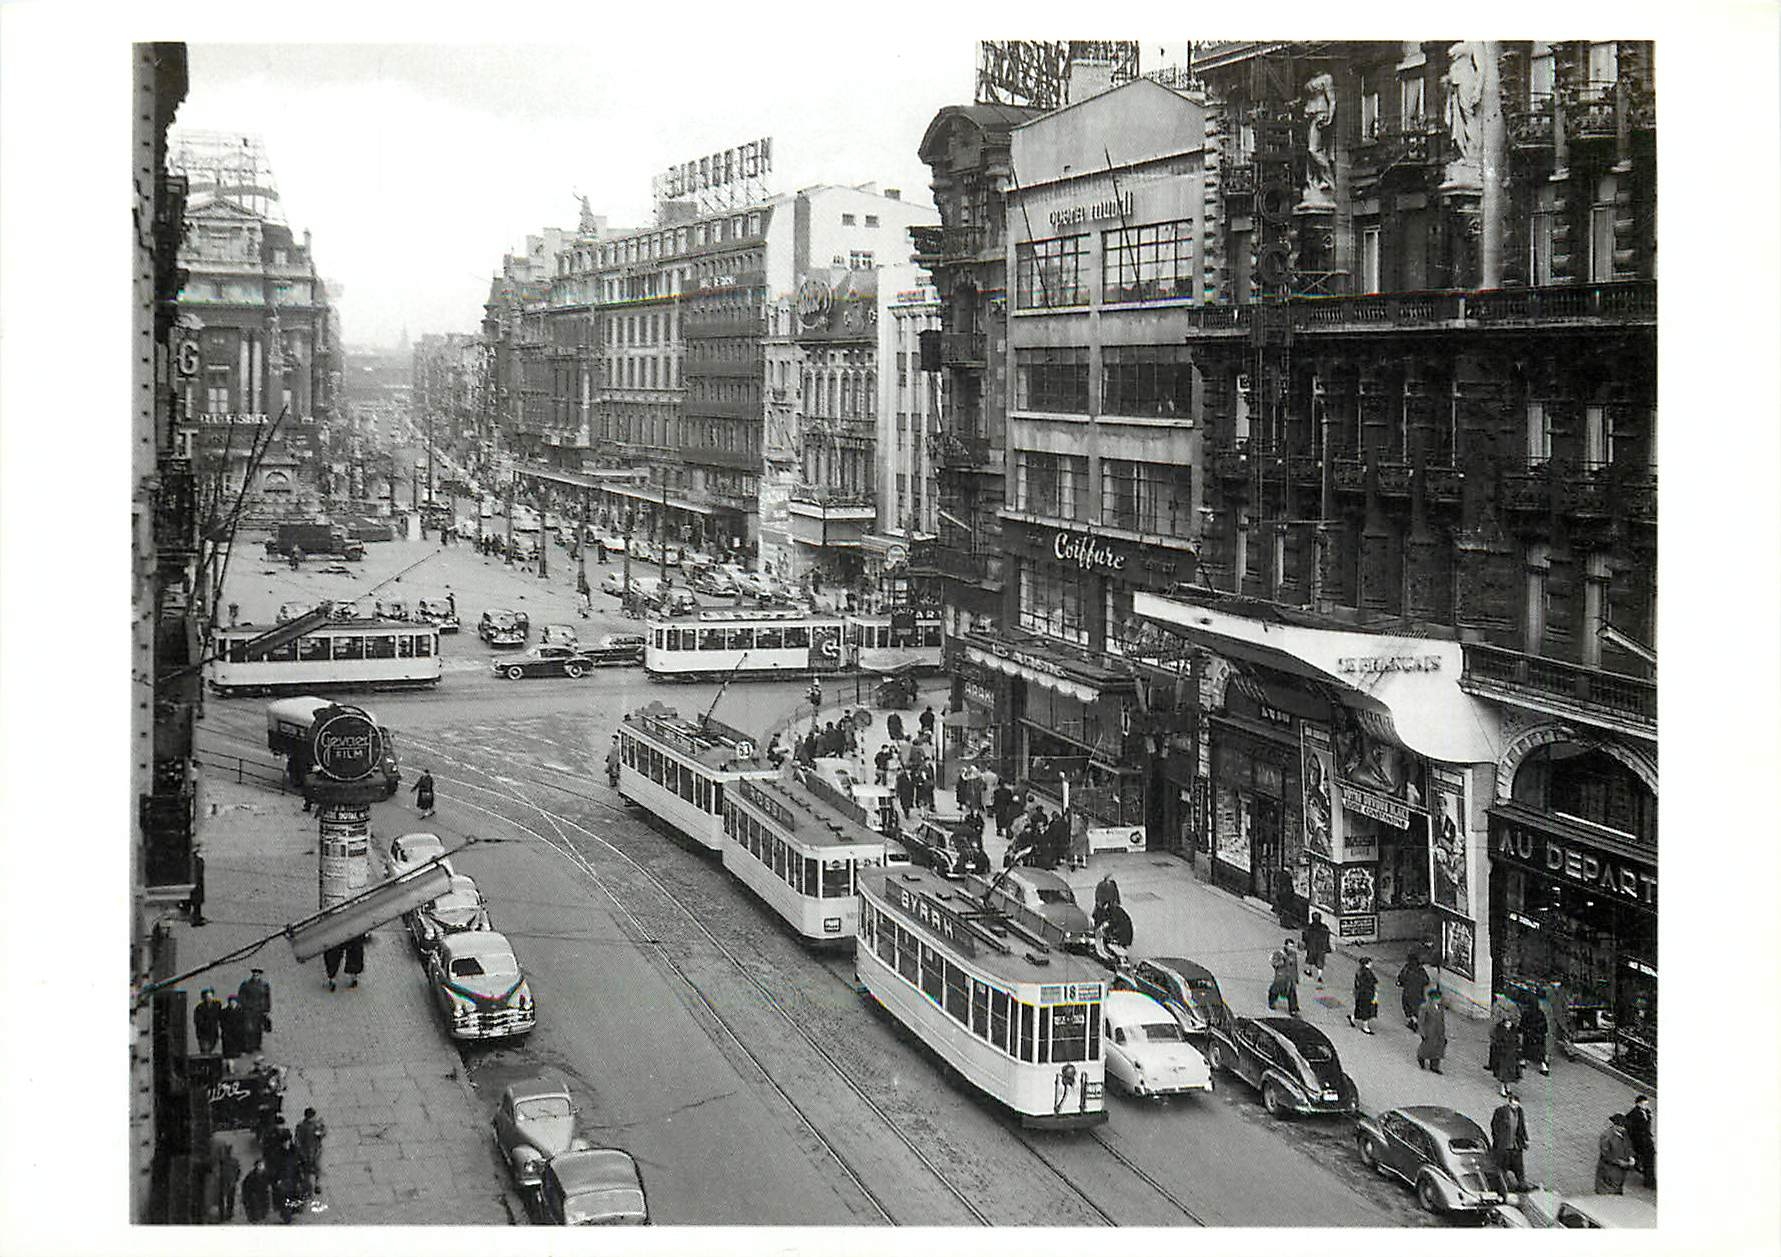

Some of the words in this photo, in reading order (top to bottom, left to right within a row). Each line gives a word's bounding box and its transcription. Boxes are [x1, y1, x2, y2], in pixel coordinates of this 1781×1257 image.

[1048, 208, 1085, 233] opera
[1054, 532, 1126, 570] Coiffure
[320, 729, 376, 768] Gevaert
[336, 750, 364, 759] FILM
[1500, 829, 1533, 859] AU
[1546, 840, 1658, 903] DEPART
[902, 889, 956, 941] BYRRH
[1064, 985, 1076, 1000] 18
